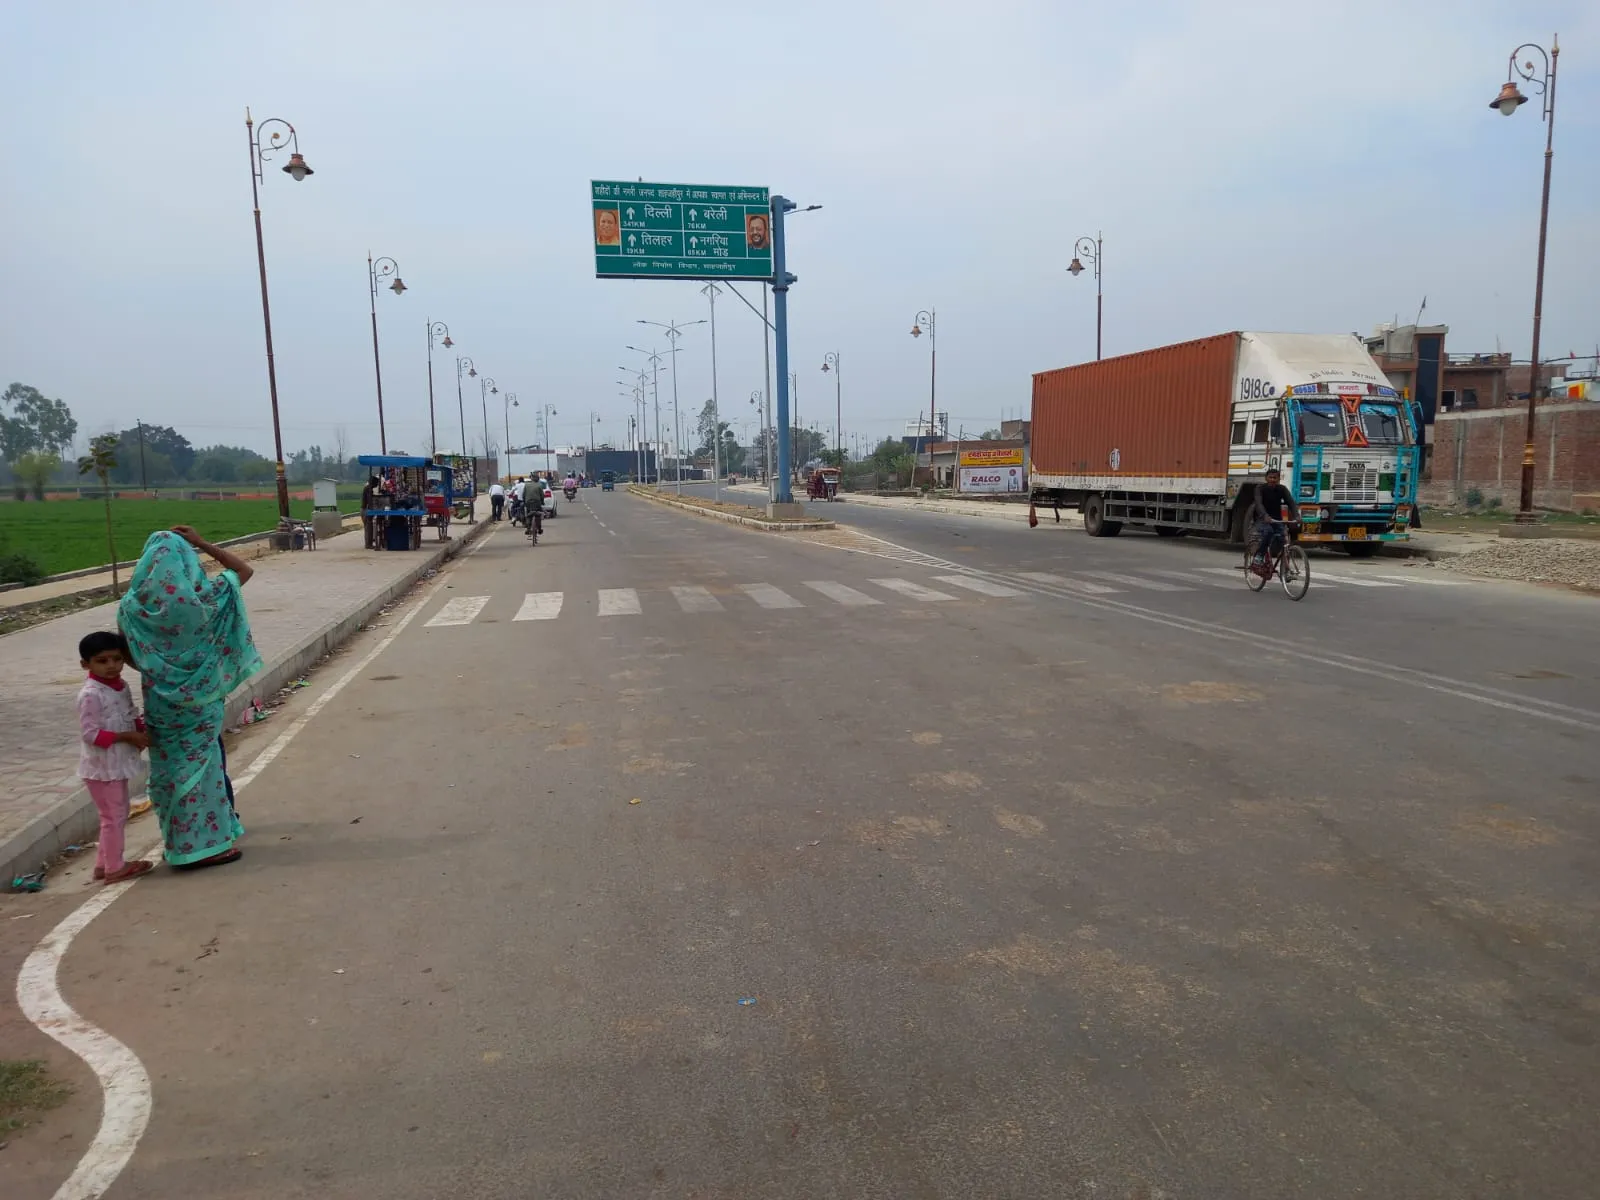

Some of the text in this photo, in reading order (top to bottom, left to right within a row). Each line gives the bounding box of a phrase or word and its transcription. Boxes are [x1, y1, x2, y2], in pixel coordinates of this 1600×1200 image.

[644, 203, 672, 219] दिल्ली
[703, 206, 728, 220] बरेली
[641, 231, 673, 247] तिलहर
[971, 475, 1001, 483] RALCO
